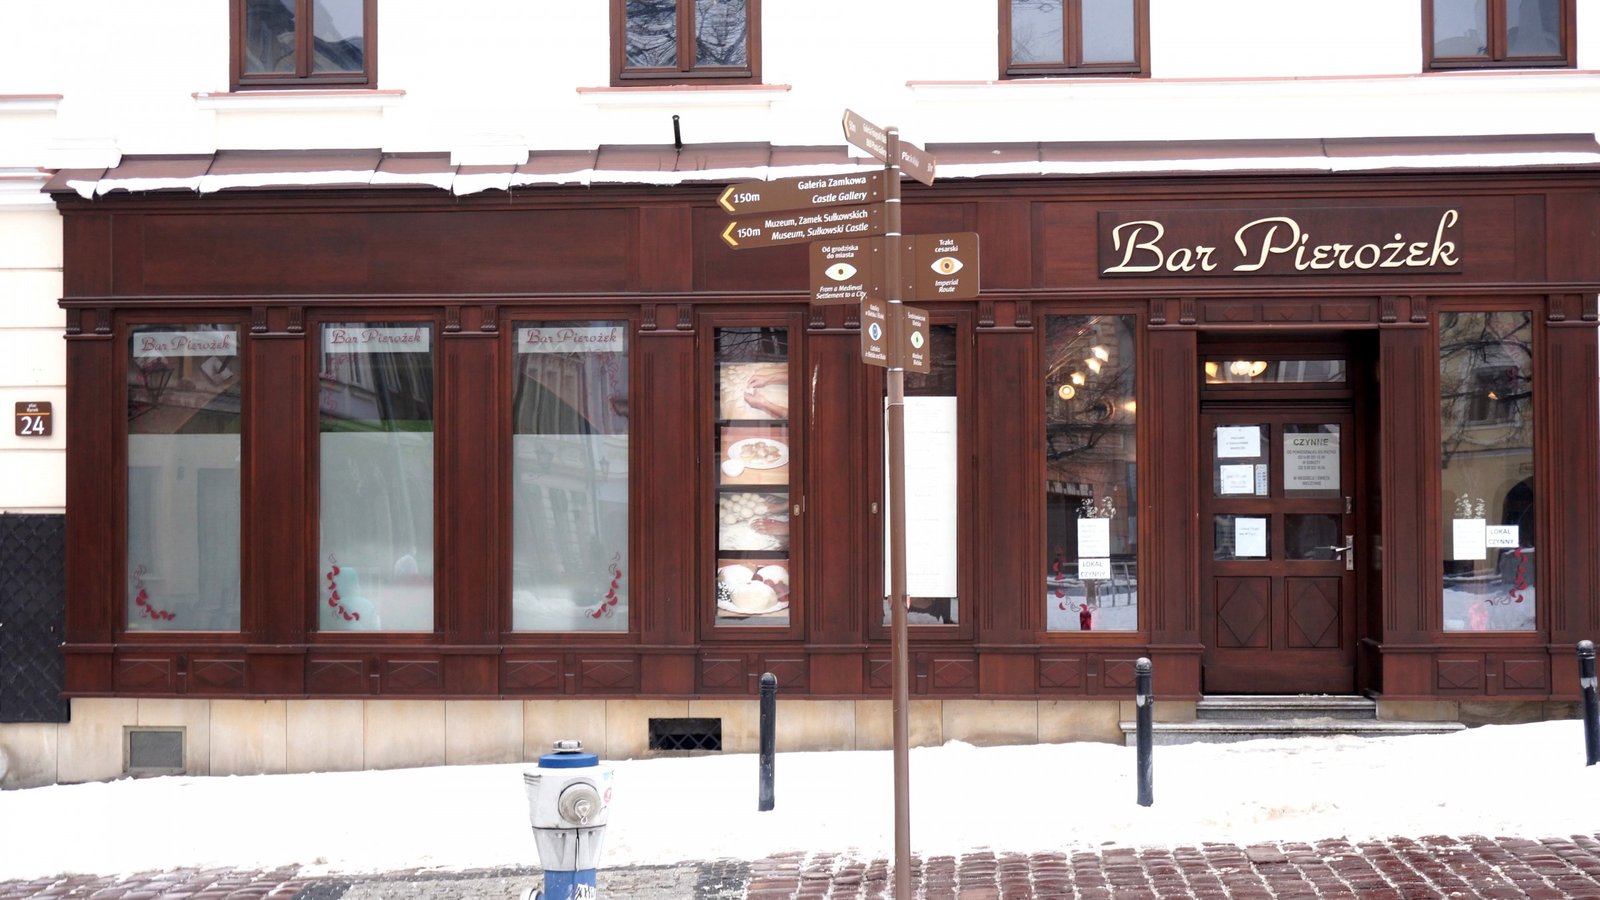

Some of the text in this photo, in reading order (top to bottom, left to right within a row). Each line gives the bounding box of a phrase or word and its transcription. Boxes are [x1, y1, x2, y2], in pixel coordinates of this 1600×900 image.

[798, 177, 867, 189] Galeria Zamkowa
[733, 192, 760, 203] 150m
[812, 191, 867, 203] Castle Gallery
[764, 210, 868, 229] Muzeum, Zamek Sułkowskich
[737, 228, 761, 238] 150m
[771, 222, 868, 240] Museum, Sułkowski Castle
[939, 238, 954, 246] Trakt
[1103, 209, 1459, 273] Bar Pierożek
[831, 245, 859, 253] grodziska
[934, 279, 960, 287] Imperial
[856, 290, 868, 300] City
[330, 328, 421, 344] Bar Pierożek
[526, 328, 617, 344] Bar Pierożek
[141, 334, 231, 351] Bar Pierożek
[20, 415, 45, 435] 24
[1293, 438, 1329, 446] CZYNNE
[1082, 560, 1103, 568] LOKAL
